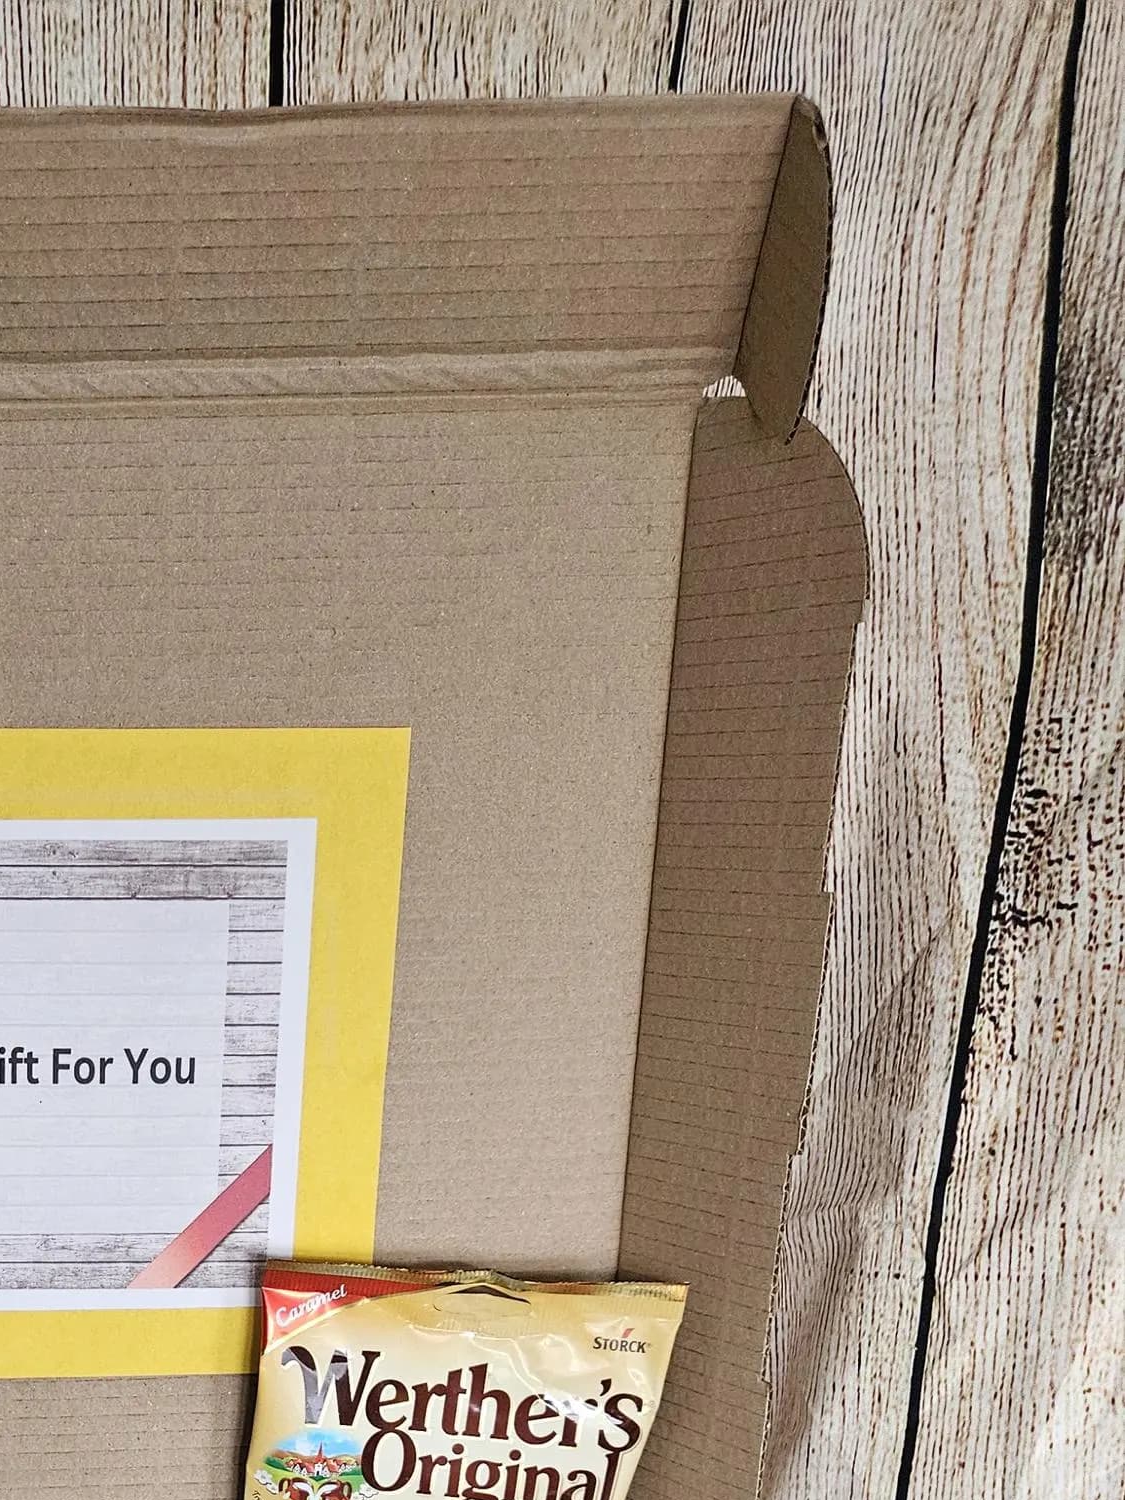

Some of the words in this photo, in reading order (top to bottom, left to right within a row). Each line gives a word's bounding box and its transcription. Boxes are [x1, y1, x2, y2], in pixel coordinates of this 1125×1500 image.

[51, 1047, 114, 1086] For
[122, 1047, 196, 1086] You
[275, 1284, 348, 1329] Caramel
[592, 1336, 647, 1354] STORCK
[281, 1345, 643, 1452] Werther's
